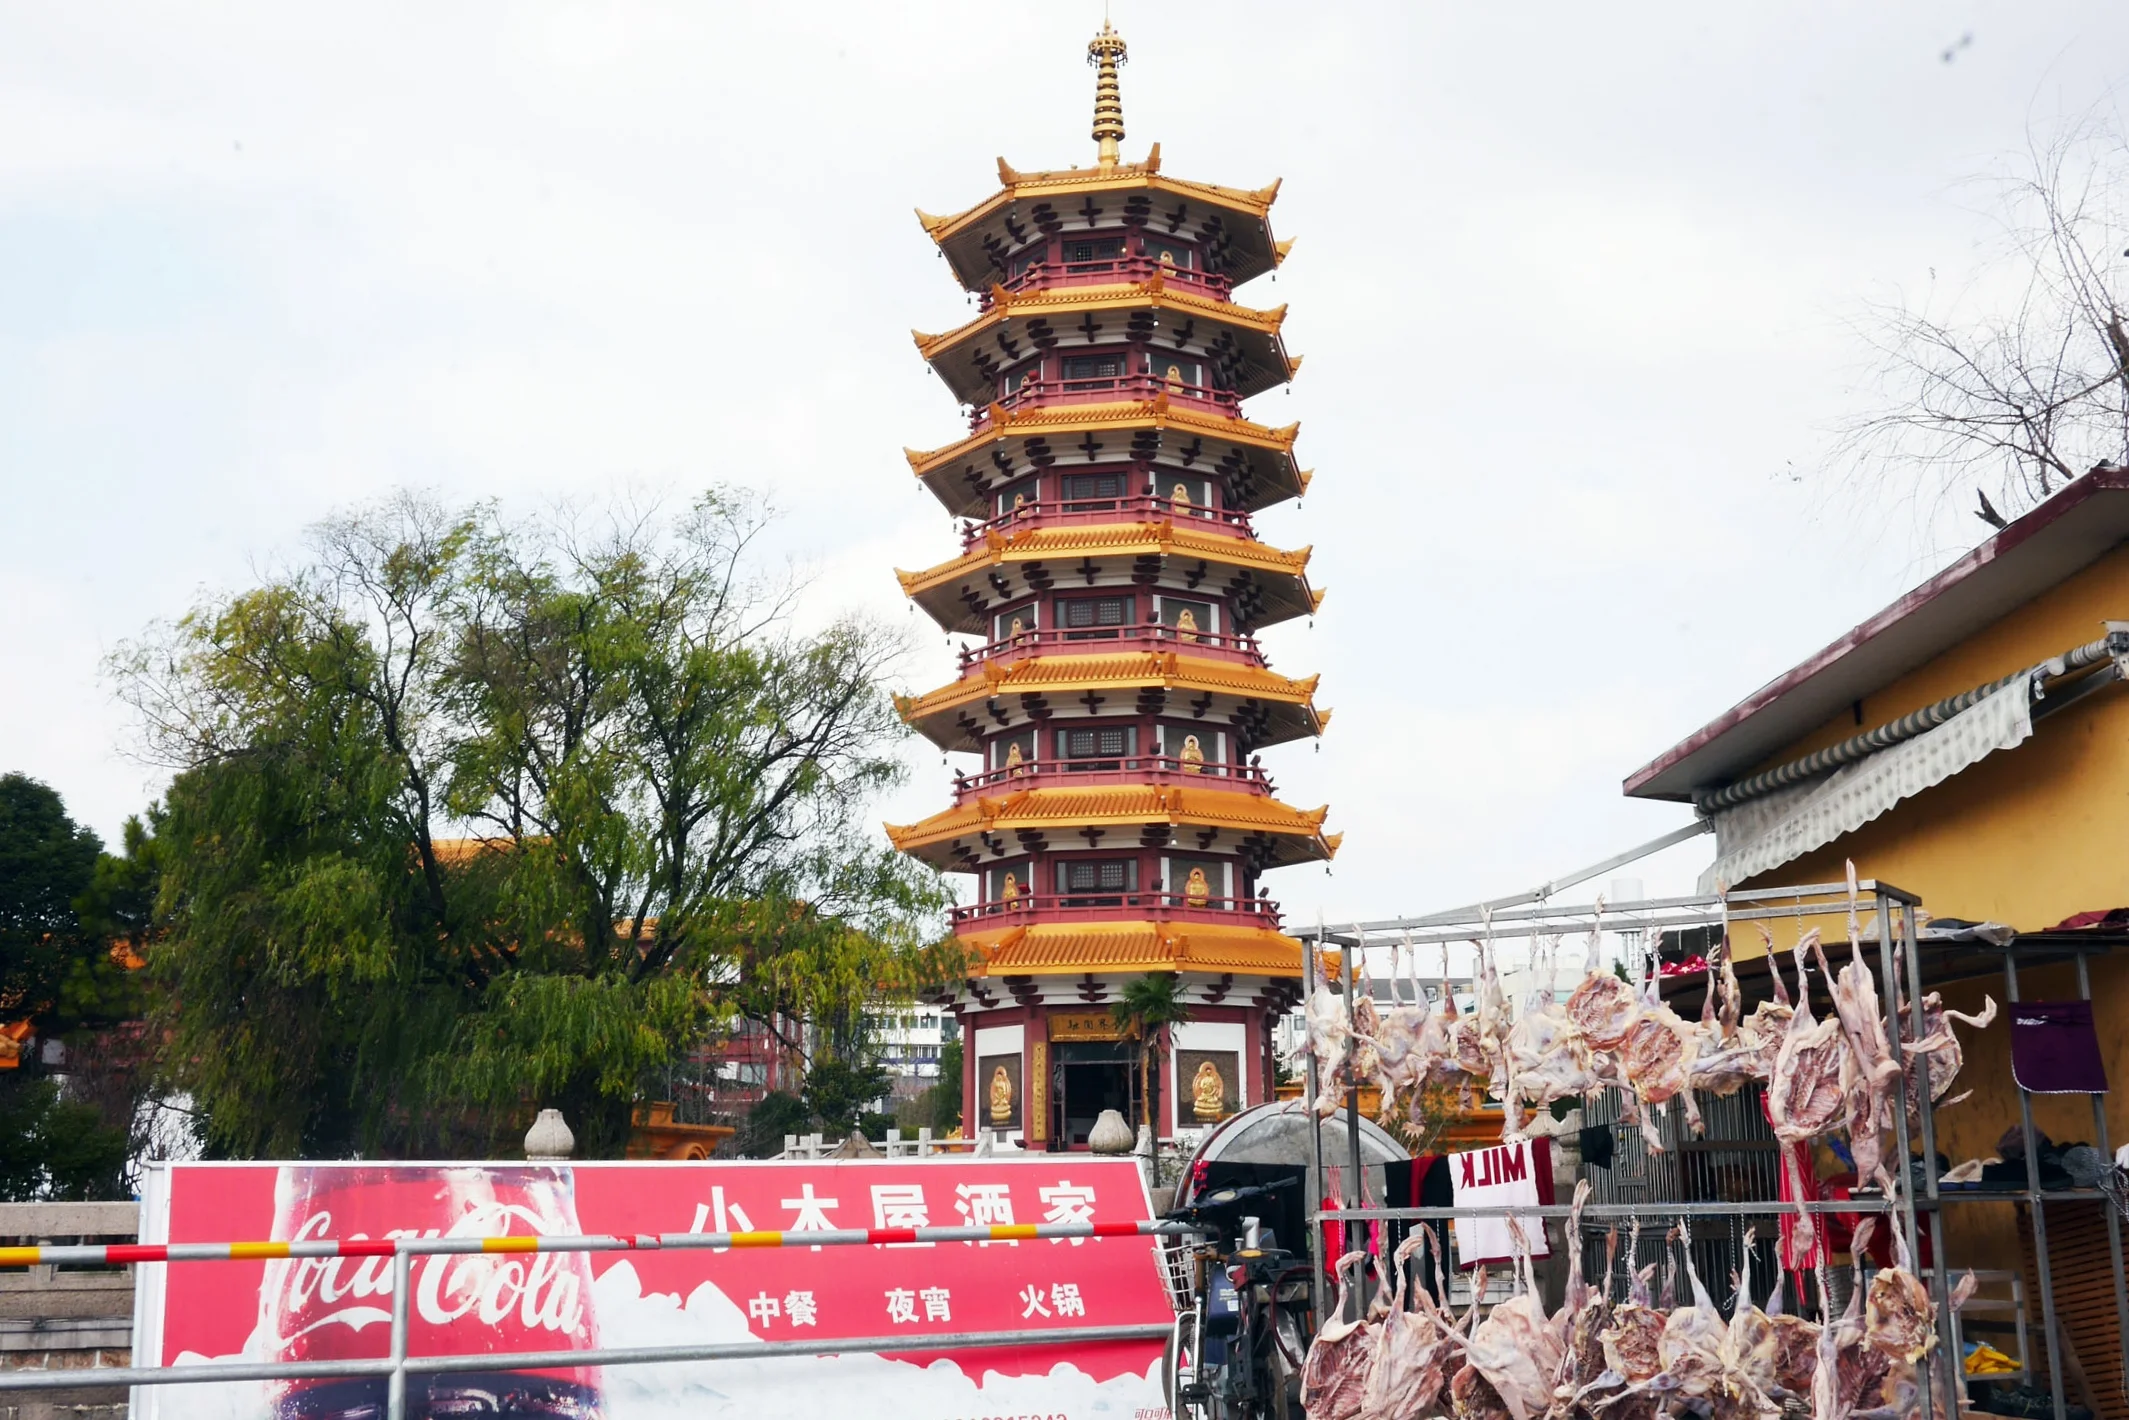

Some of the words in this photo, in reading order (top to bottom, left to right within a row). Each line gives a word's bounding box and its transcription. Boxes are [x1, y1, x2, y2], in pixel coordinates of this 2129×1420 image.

[749, 1290, 818, 1328] 中餐
[885, 1287, 952, 1324] 夜宵
[1018, 1283, 1087, 1319] 火锅
